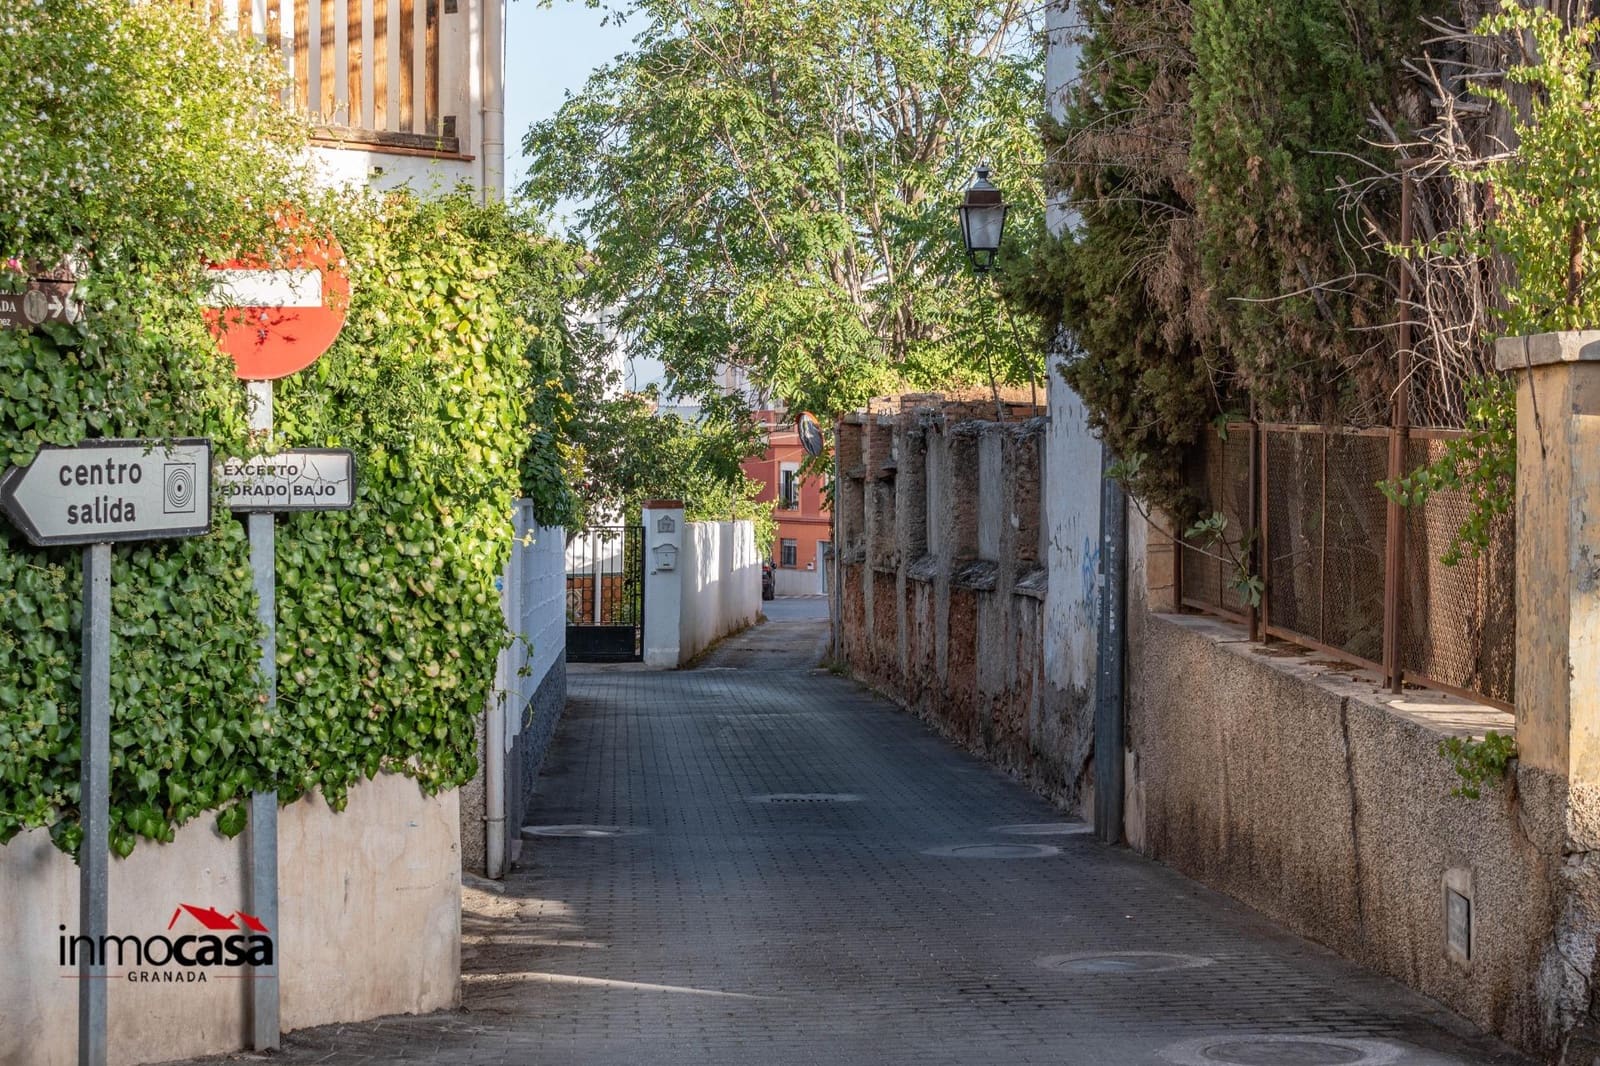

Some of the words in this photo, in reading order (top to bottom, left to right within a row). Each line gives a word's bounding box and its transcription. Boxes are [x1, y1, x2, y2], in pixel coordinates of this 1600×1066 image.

[0, 300, 17, 312] DA
[59, 457, 142, 486] centro
[216, 485, 288, 496] EDRADO
[293, 485, 336, 496] BAJO
[67, 495, 136, 524] salida
